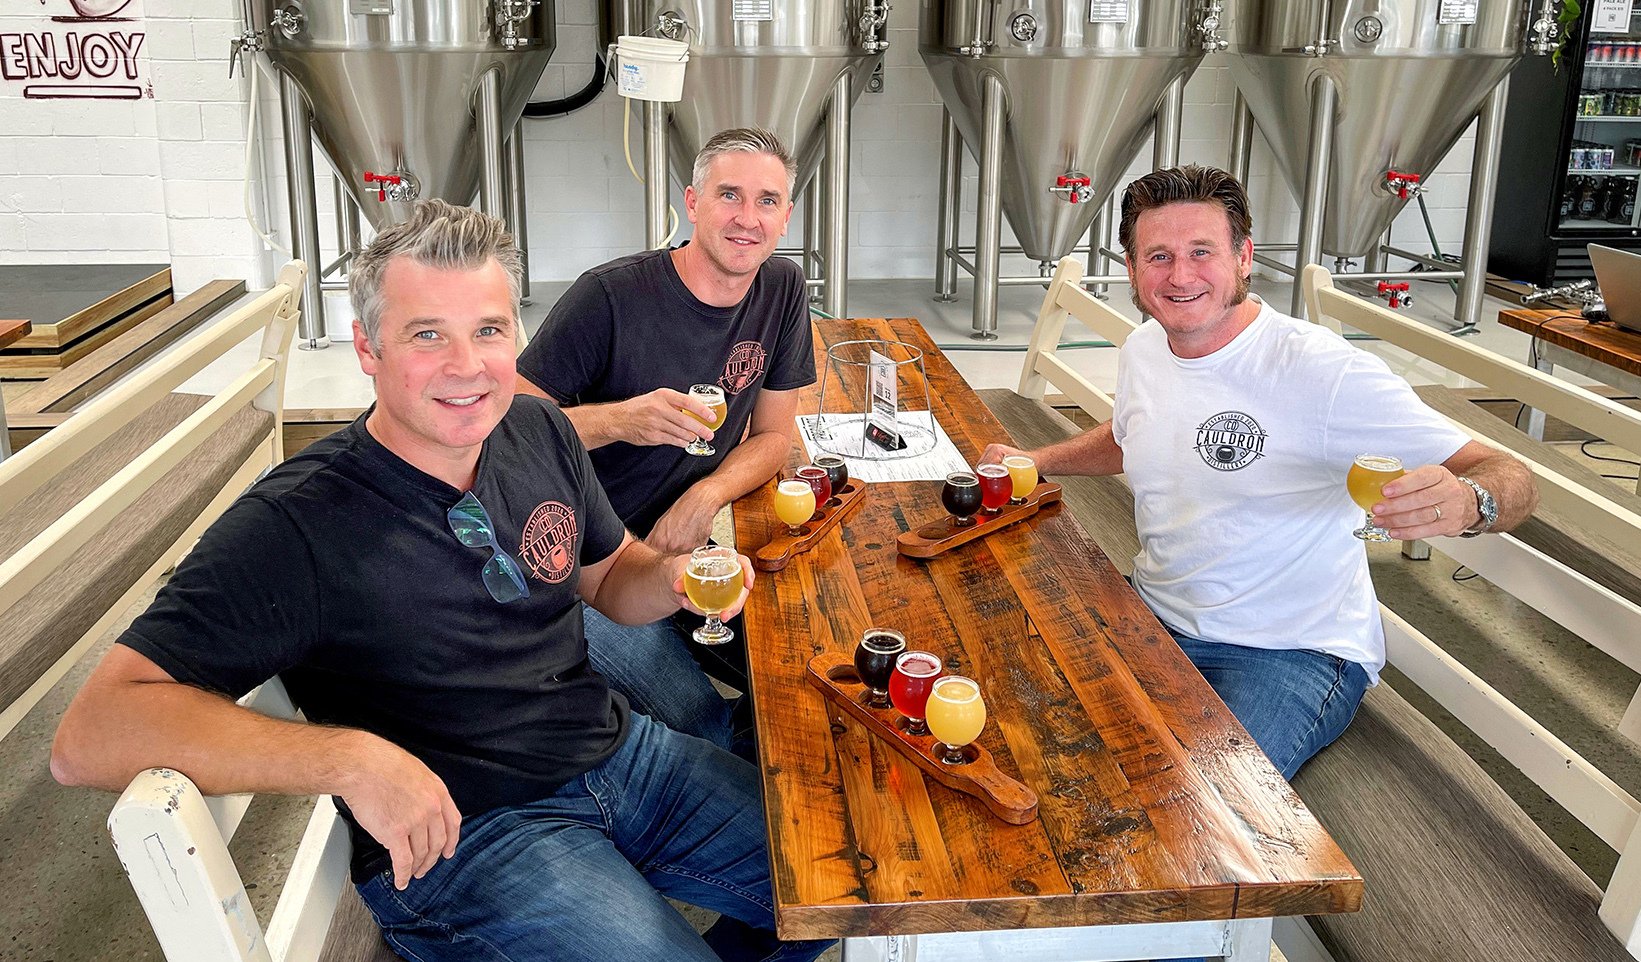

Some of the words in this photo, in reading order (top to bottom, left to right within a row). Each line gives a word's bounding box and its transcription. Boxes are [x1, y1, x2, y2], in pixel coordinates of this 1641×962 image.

[0, 32, 145, 80] ENJOY
[1196, 430, 1265, 453] CAULDRON
[523, 512, 577, 571] CAULDRON
